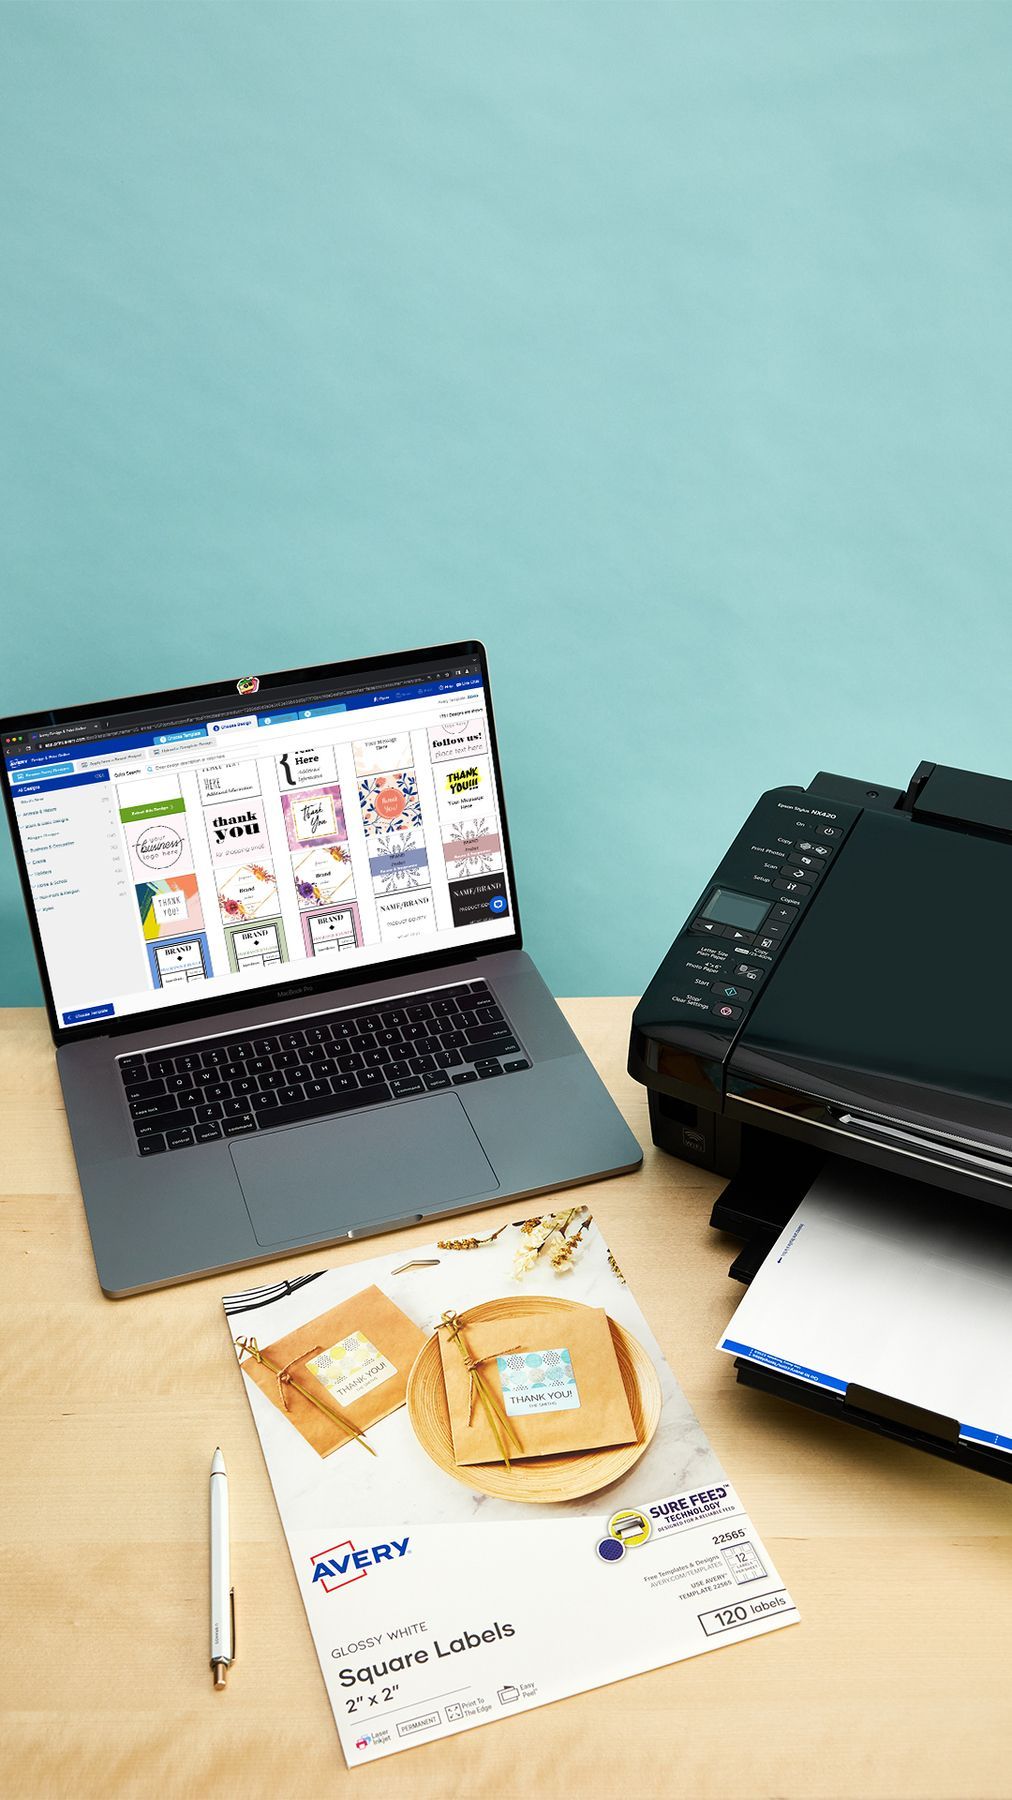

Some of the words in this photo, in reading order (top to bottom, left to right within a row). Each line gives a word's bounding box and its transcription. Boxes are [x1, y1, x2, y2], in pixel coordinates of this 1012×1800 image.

[433, 737, 464, 747] follow
[467, 733, 482, 741] us!
[295, 755, 319, 765] Here
[436, 749, 453, 759] place
[446, 767, 478, 782] THANK
[450, 778, 478, 794] YOU!!!
[301, 803, 323, 821] Thank
[811, 810, 837, 819] NX420
[212, 812, 257, 827] thank
[311, 816, 327, 833] You
[214, 823, 260, 844] you
[141, 838, 181, 853] business
[753, 875, 770, 883] Setup
[454, 882, 502, 897] NAME/BRAND
[158, 896, 181, 907] THANK
[380, 897, 429, 912] NAME/BRAND
[780, 896, 800, 906] Copies
[163, 908, 180, 916] YOU!
[459, 904, 480, 912] PRODUCT
[318, 915, 344, 924] BRAND
[242, 930, 268, 940] BRAND
[165, 945, 192, 956] BRAND
[701, 946, 717, 954] Letter
[686, 962, 702, 970] Photo
[694, 978, 710, 987] Start
[277, 988, 302, 997] MacBook
[686, 1000, 709, 1010] Settings
[336, 1374, 368, 1396] THANK
[367, 1361, 387, 1378] YOU!
[510, 1393, 546, 1404] THANK
[548, 1390, 573, 1399] YOU!
[649, 1498, 690, 1518] SURE
[664, 1501, 721, 1523] TECHNOLOGY
[658, 1521, 683, 1533] DESIGNED
[699, 1510, 722, 1520] RELIABLE
[735, 1552, 748, 1563] 12
[644, 1572, 658, 1582] Free
[658, 1563, 689, 1577] Templates
[695, 1554, 720, 1567] Designs
[678, 1586, 713, 1601] TEMPLATE
[713, 1580, 733, 1590] 22565
[690, 1580, 703, 1589] USE
[714, 1606, 747, 1626] 120
[750, 1597, 787, 1614] labels
[331, 1634, 383, 1660] GLOSSY
[386, 1621, 429, 1641] WHITE
[338, 1649, 429, 1688] Square
[433, 1622, 516, 1659] Labels
[520, 1682, 536, 1692] Easy
[369, 1694, 379, 1706] x
[461, 1699, 477, 1709] Print
[464, 1709, 476, 1717] The
[476, 1703, 493, 1714] Edge
[401, 1716, 437, 1732] PERMANENT
[371, 1728, 389, 1739] Laser
[372, 1734, 392, 1746] Inkjet
